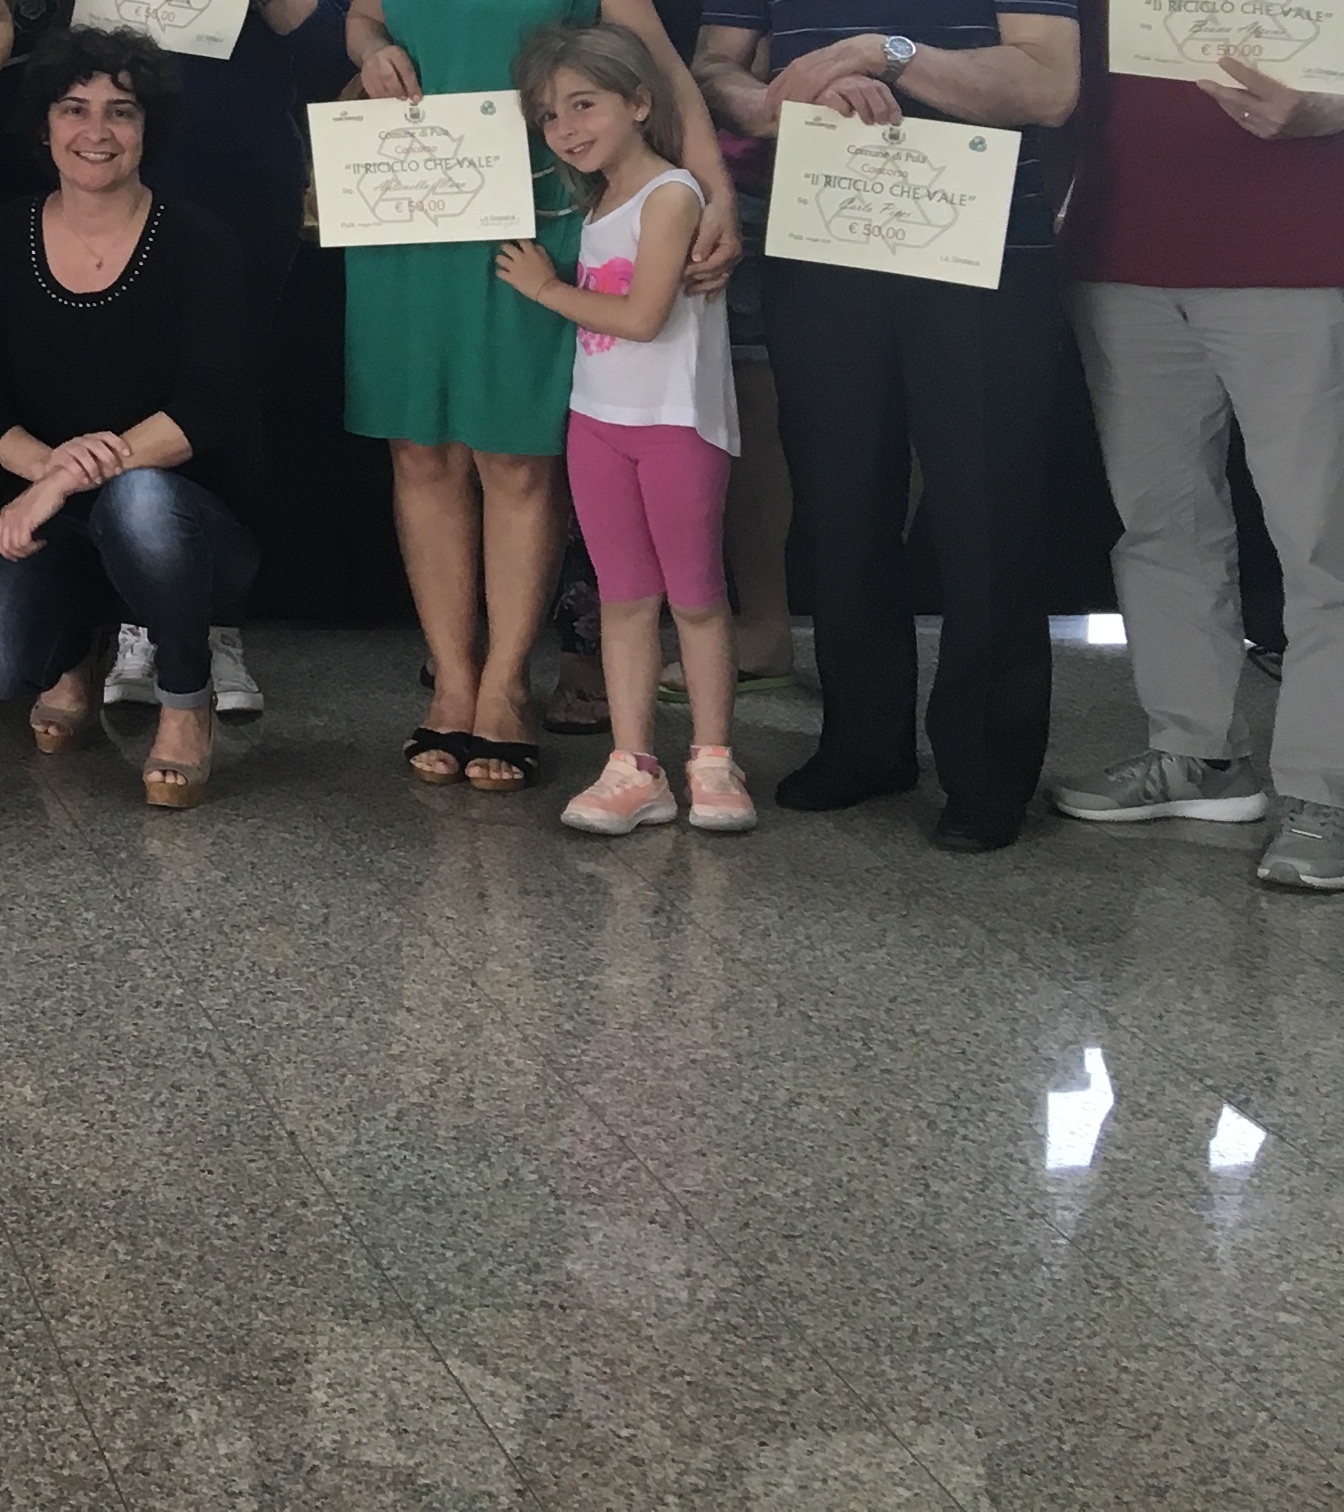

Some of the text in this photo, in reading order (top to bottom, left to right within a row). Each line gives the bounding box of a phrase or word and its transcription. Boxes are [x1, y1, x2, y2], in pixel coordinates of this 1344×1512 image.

[1168, 0, 1235, 13] RICICLO
[1241, 1, 1277, 15] CHE
[1201, 44, 1211, 56] €
[378, 128, 449, 140] Comune di Pula
[394, 144, 438, 154] Concorso
[847, 144, 927, 164] Comune di Pula
[364, 160, 420, 174] RICICLO
[424, 157, 451, 170] CHE
[861, 163, 909, 178] Concorso
[824, 175, 885, 195] RICICLO
[889, 185, 920, 200] CHE
[926, 190, 976, 207] VALE”
[395, 199, 446, 214] € 50,00
[848, 222, 906, 240] € 50,00
